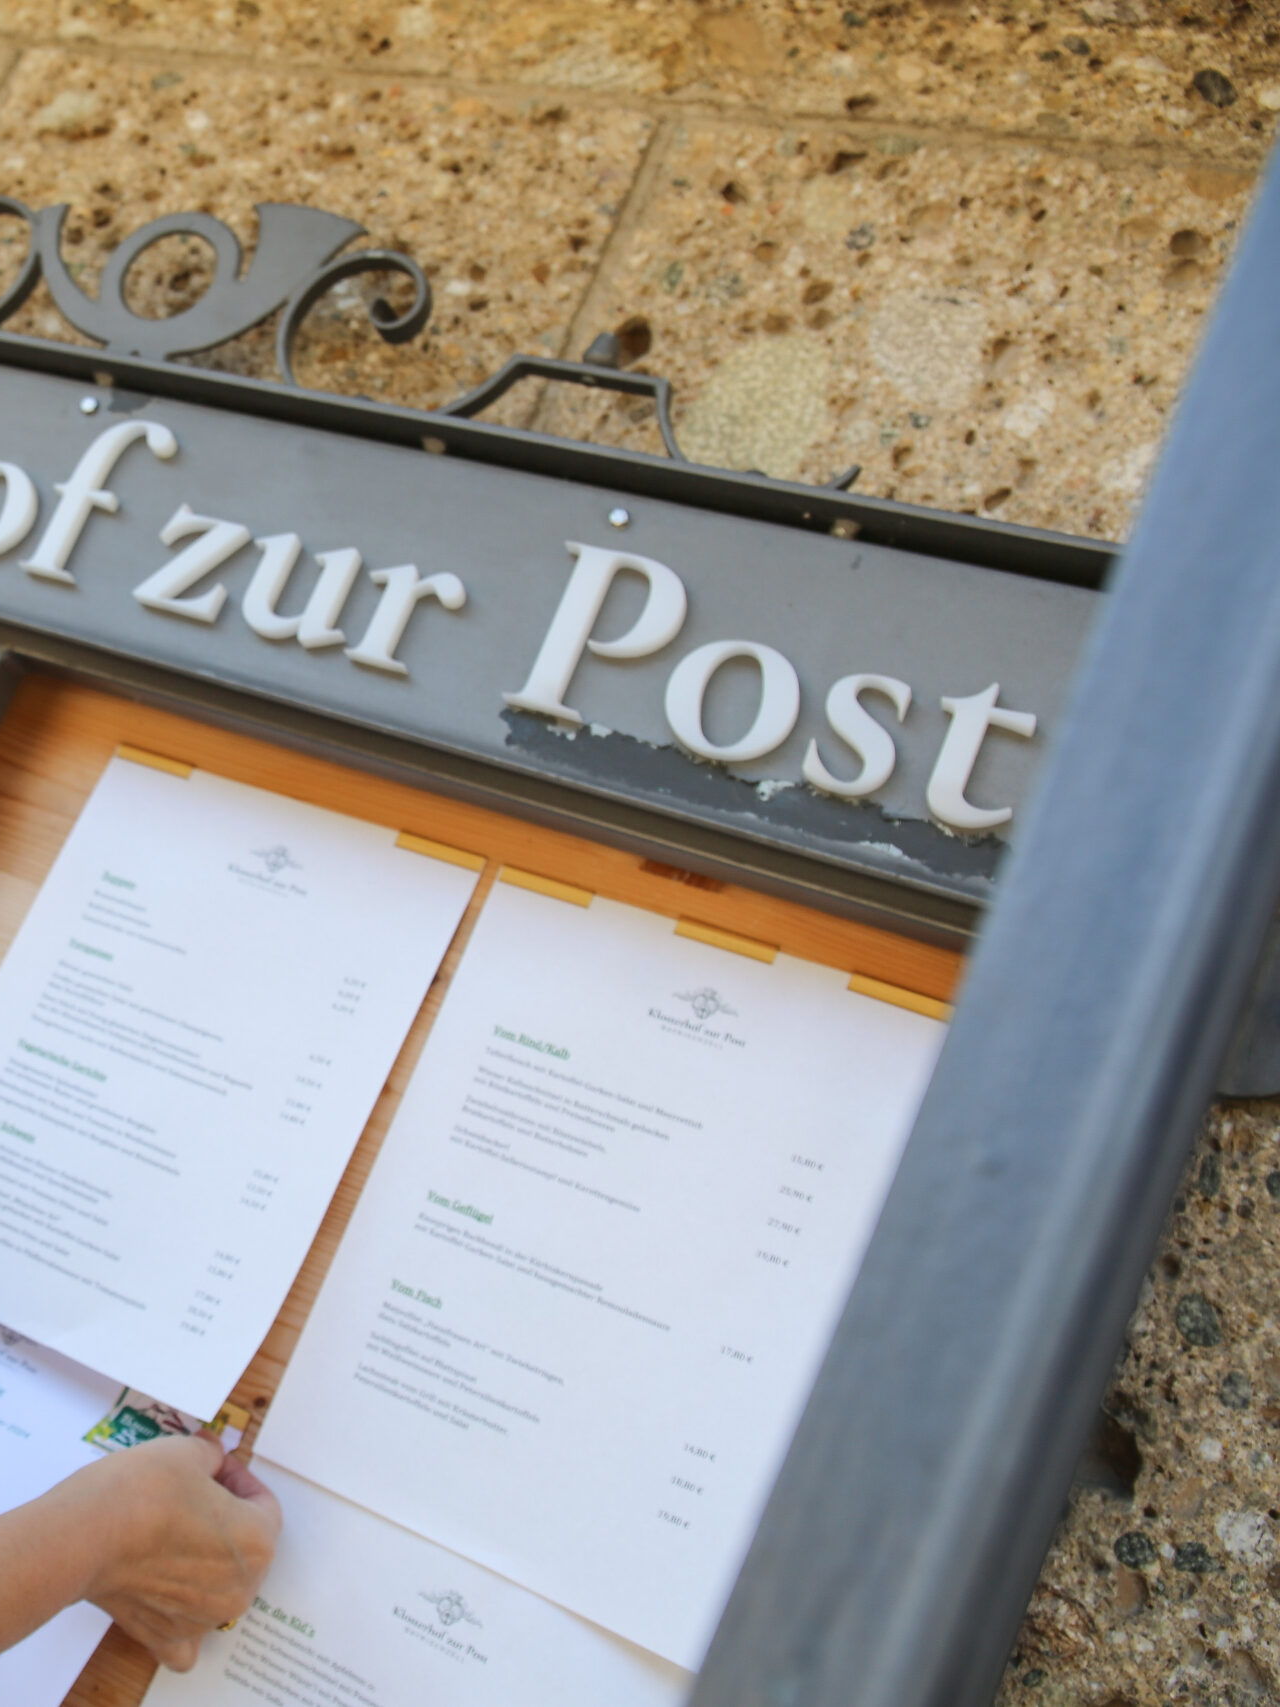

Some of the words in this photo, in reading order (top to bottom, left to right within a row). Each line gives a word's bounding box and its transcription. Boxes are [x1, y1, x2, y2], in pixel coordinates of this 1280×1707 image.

[132, 504, 467, 680] zur
[502, 538, 1039, 830] Post
[494, 1026, 516, 1040] Vom
[427, 1191, 450, 1206] Vom
[390, 1280, 414, 1296] Vom
[416, 1290, 443, 1308] Fisch
